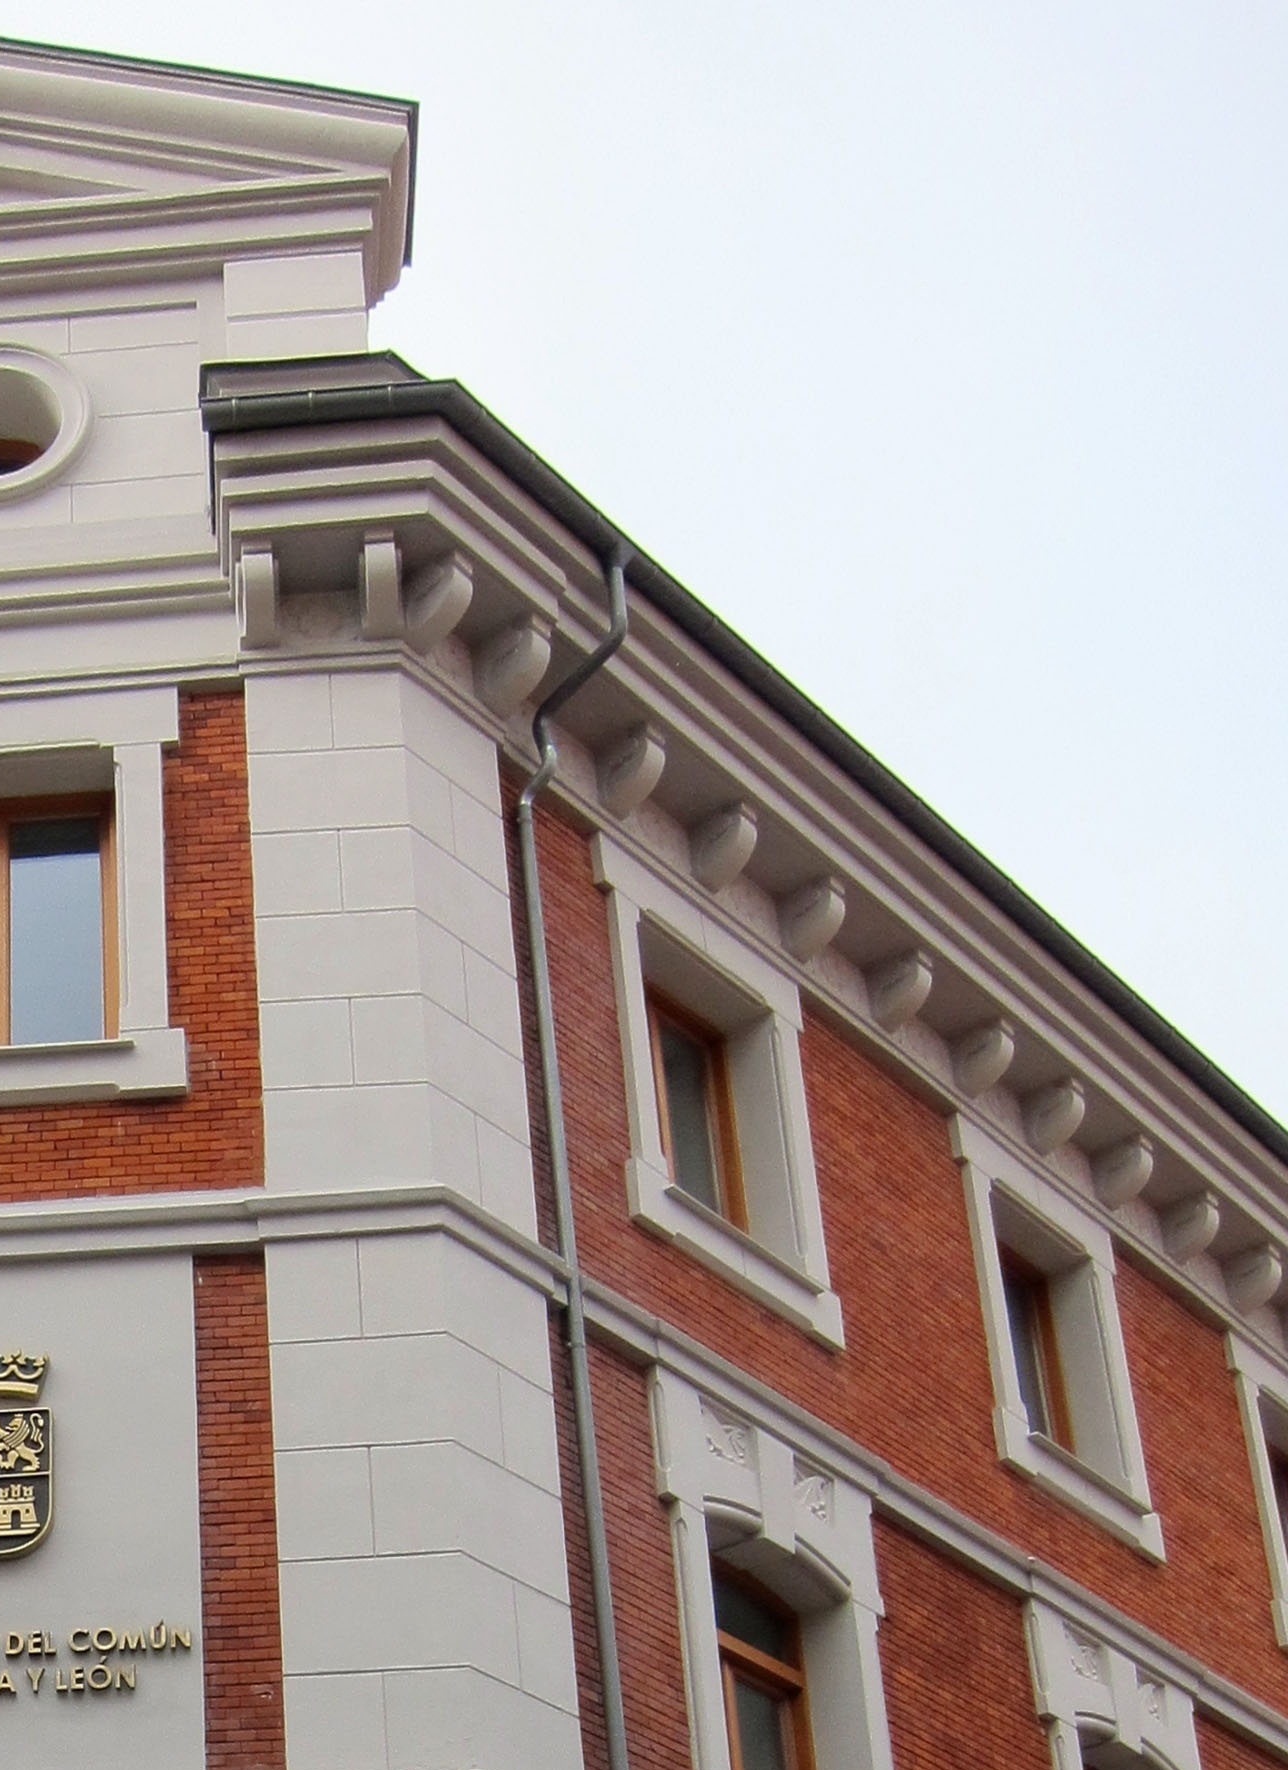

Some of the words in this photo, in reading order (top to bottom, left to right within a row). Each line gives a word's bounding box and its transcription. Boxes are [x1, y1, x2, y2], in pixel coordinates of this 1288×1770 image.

[5, 1631, 57, 1656] DEL
[68, 1621, 191, 1652] COMÚN
[26, 1668, 46, 1693] Y
[56, 1656, 137, 1691] LEÓN
